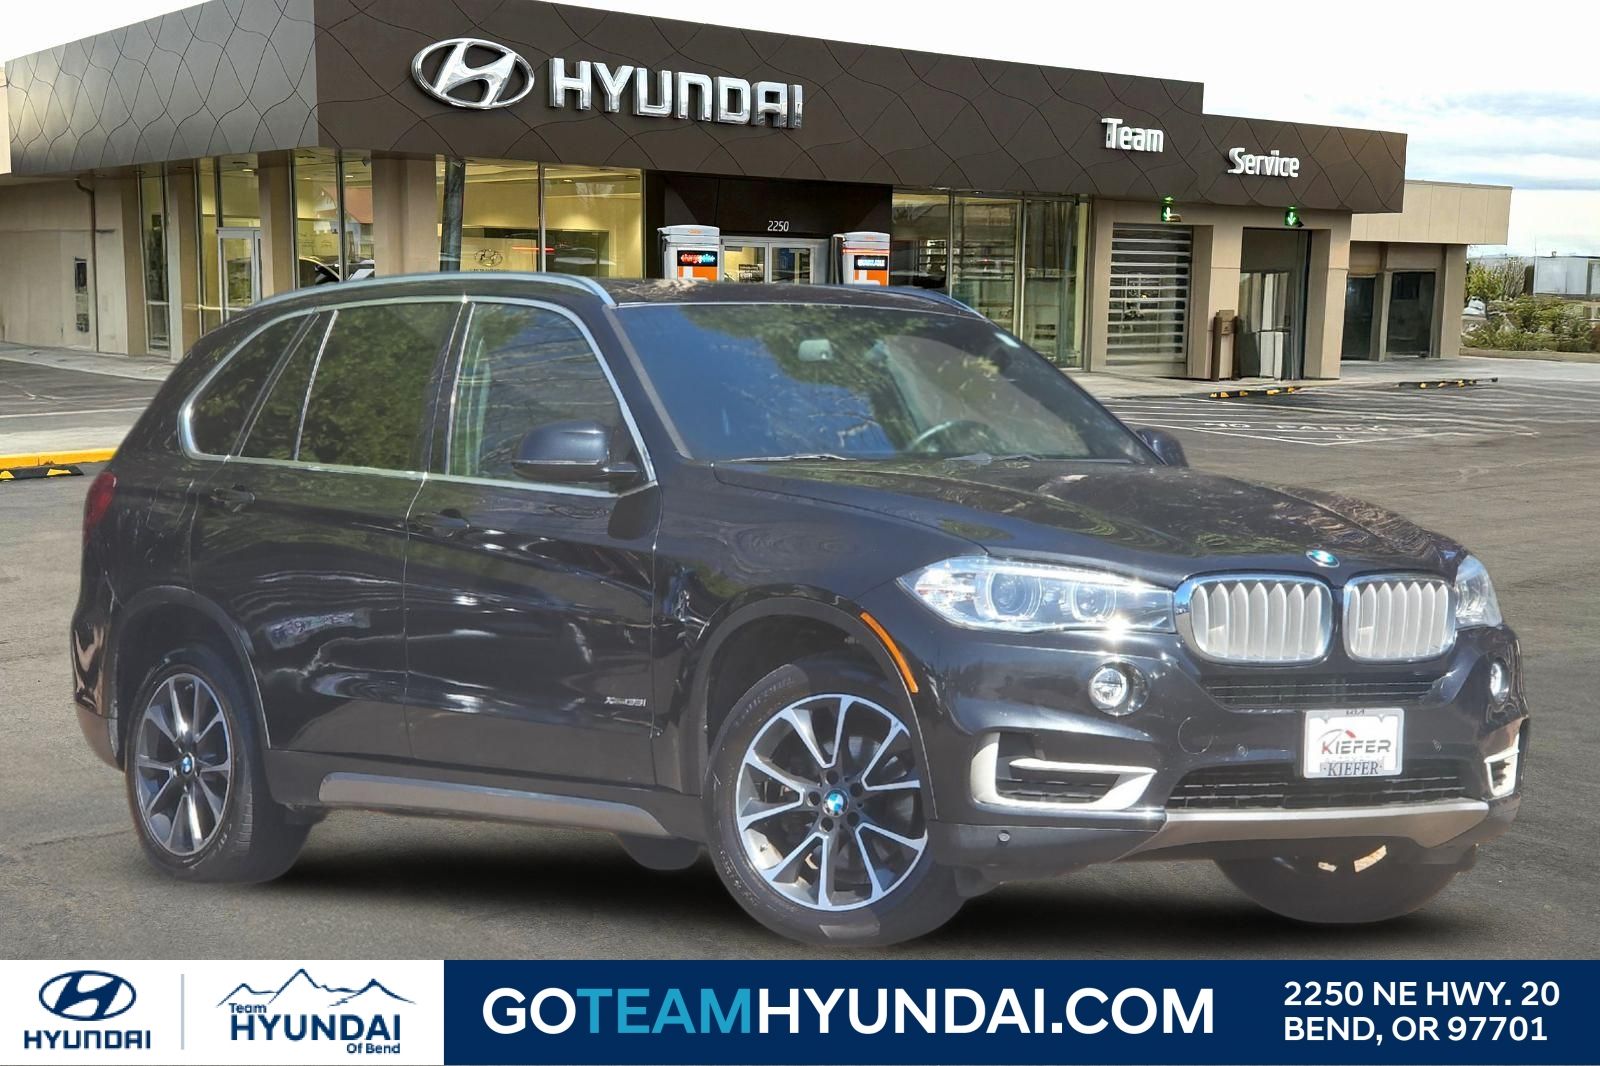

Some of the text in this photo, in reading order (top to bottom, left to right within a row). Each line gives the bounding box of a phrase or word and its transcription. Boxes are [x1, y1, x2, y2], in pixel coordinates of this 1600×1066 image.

[549, 57, 803, 129] HYUNDAI
[1102, 117, 1164, 152] Team
[1227, 147, 1300, 177] Service
[767, 220, 790, 232] 2250
[1321, 740, 1392, 755] KIEFER
[1327, 761, 1379, 777] KIEFER
